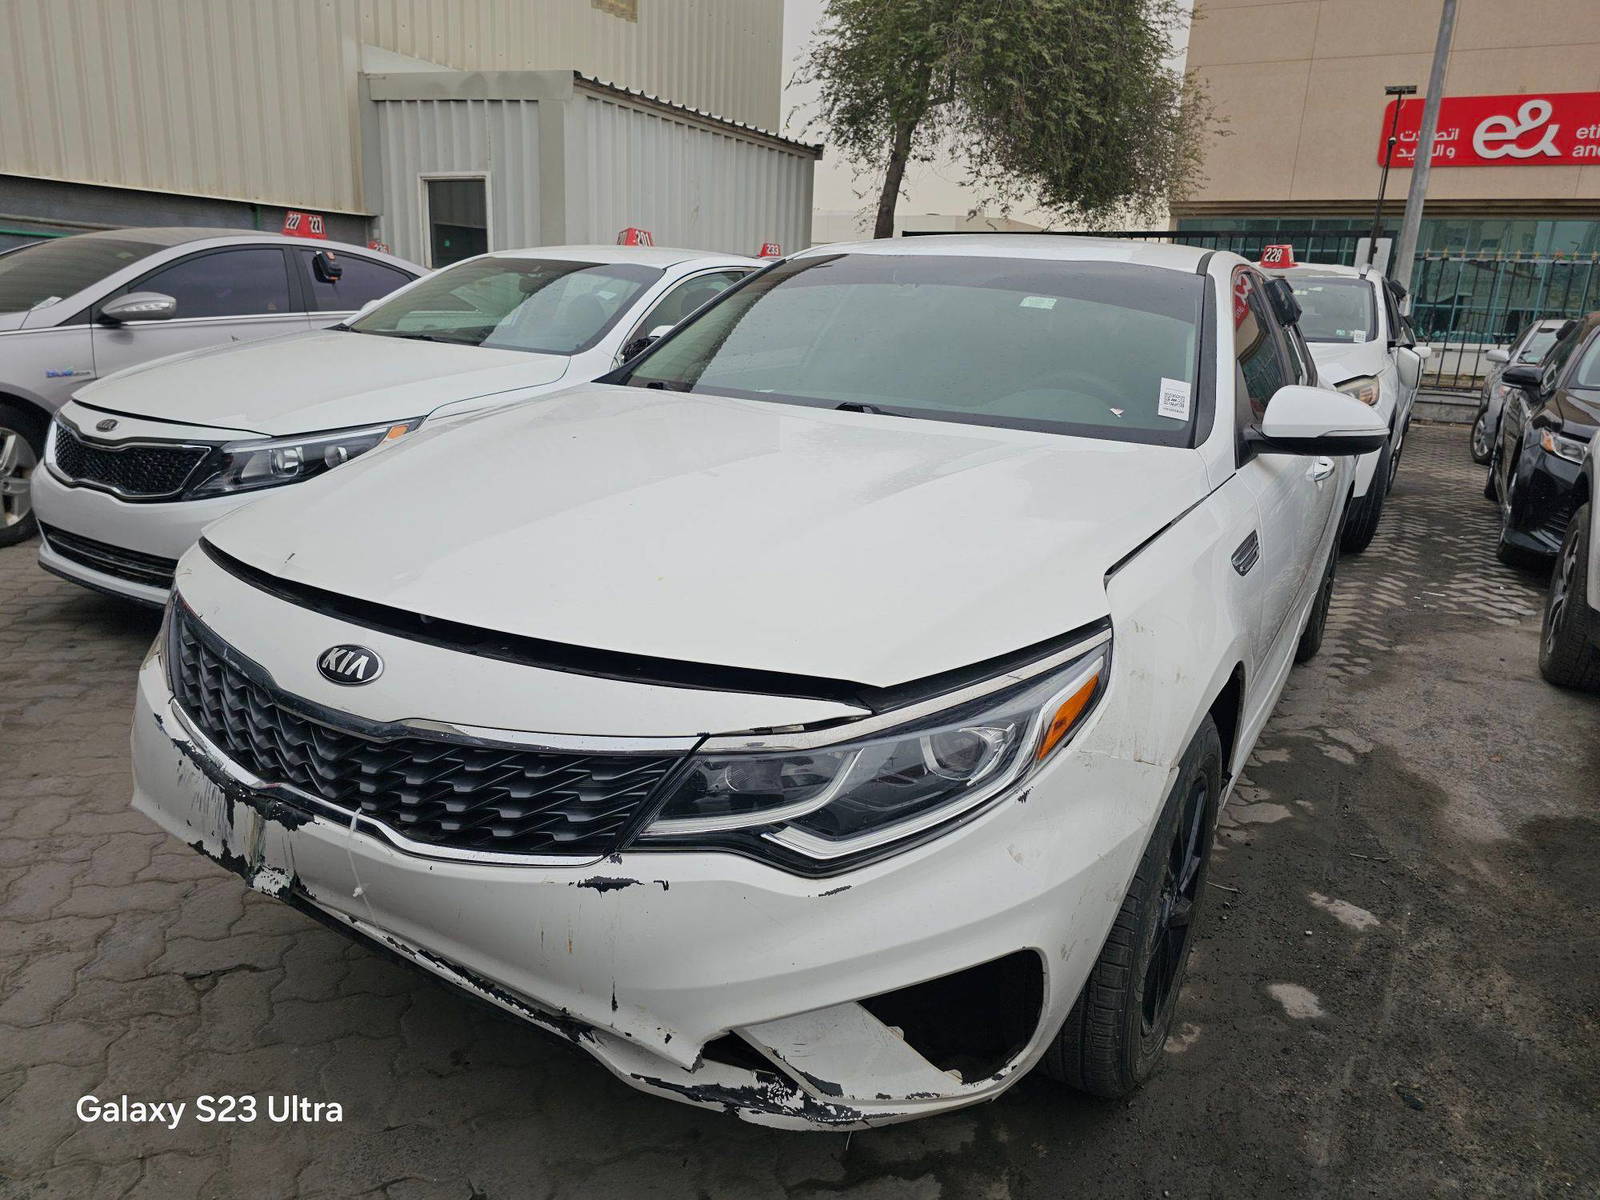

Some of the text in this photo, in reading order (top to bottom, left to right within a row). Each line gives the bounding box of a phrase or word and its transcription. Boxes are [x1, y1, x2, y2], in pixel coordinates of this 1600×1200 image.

[1472, 99, 1562, 159] e&
[1263, 247, 1283, 263] 228
[321, 647, 370, 680] KIA
